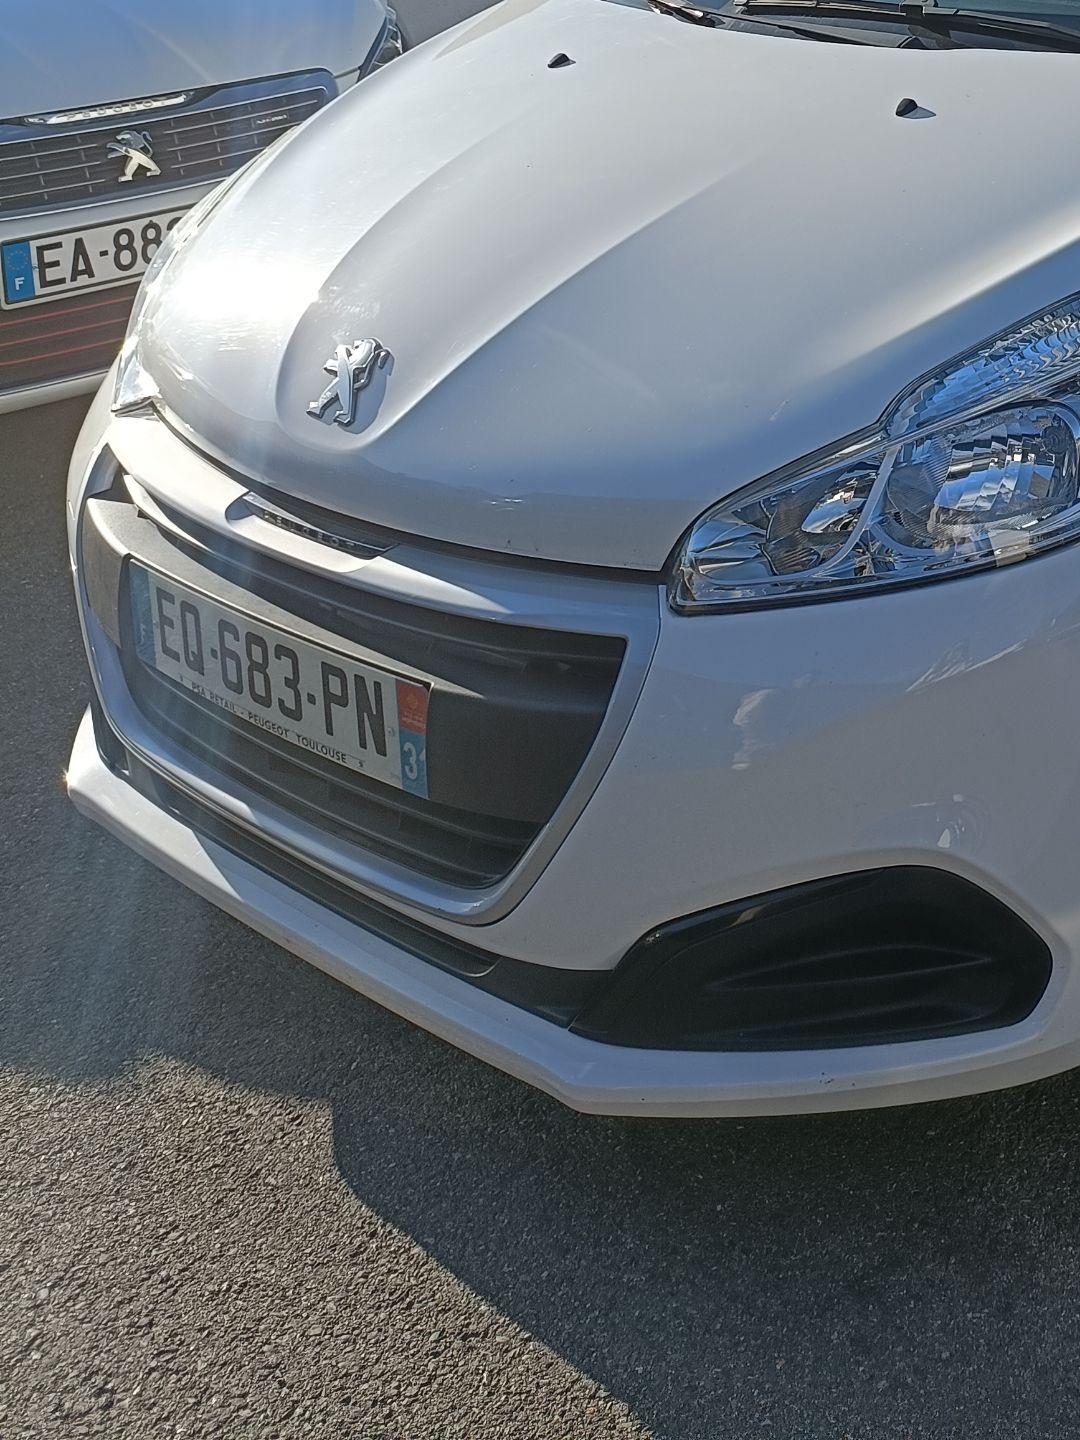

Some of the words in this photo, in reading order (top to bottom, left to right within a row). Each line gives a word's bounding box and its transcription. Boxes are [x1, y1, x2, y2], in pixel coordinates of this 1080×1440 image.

[14, 276, 25, 291] F
[36, 216, 183, 289] EA-88
[156, 585, 388, 758] EQ-683-PN
[248, 711, 289, 739] PEUGEOT
[296, 733, 348, 763] TOULOUSE
